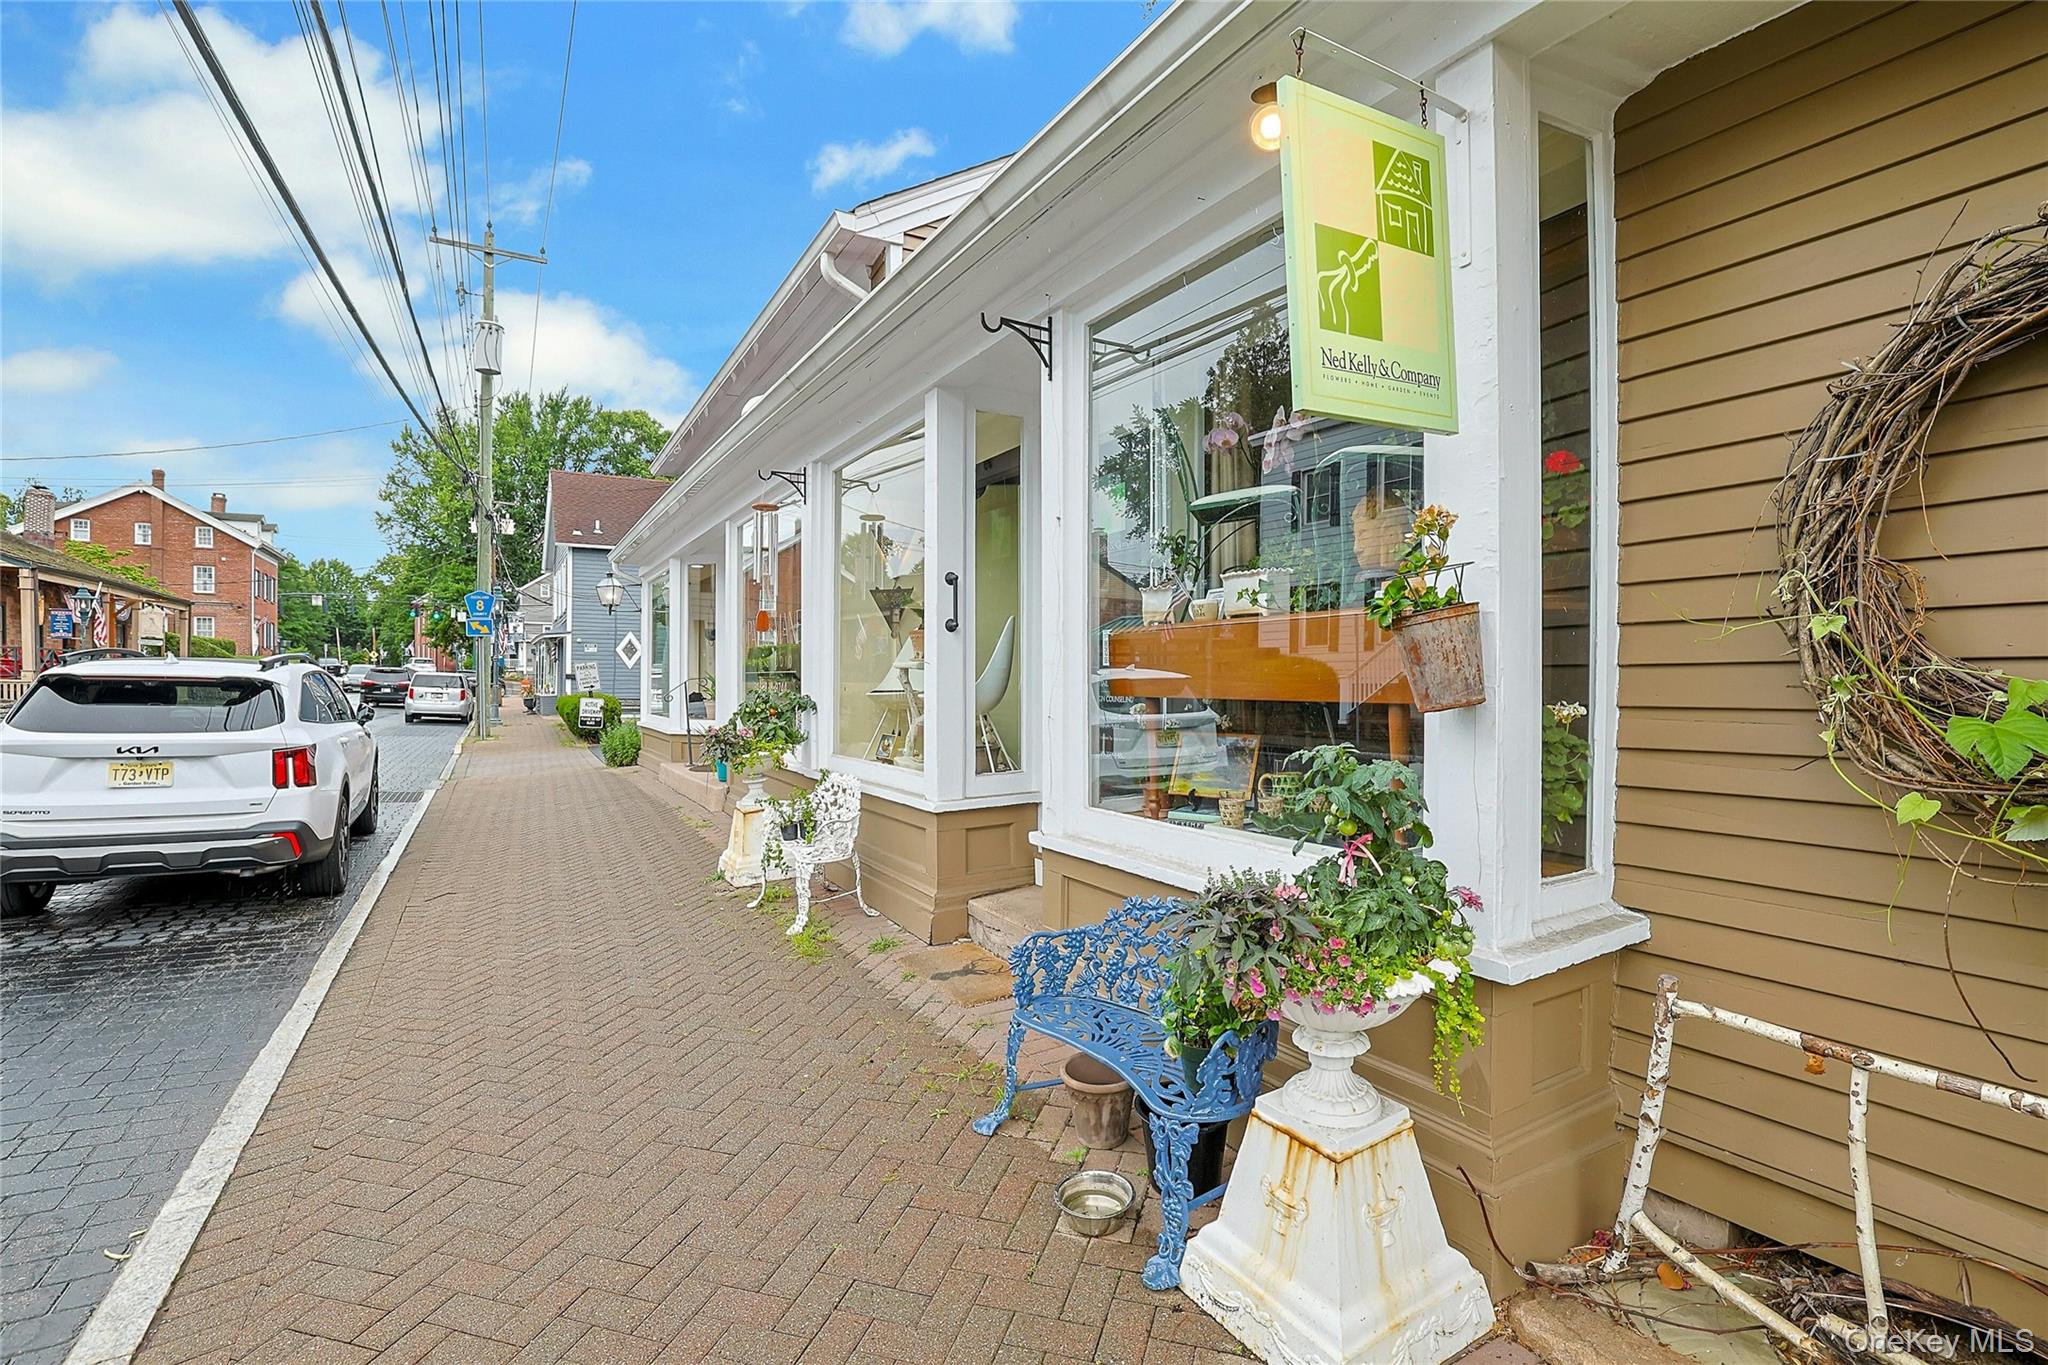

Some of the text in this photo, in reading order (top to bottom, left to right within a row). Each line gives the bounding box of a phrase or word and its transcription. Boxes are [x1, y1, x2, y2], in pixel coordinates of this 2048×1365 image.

[1320, 346, 1441, 391] Ned Kelly & Company
[1322, 373, 1440, 400] FLOWERS HOME GARDEN EVENTS
[476, 600, 485, 611] 8
[576, 663, 597, 671] PARKING
[116, 745, 159, 754] KIA
